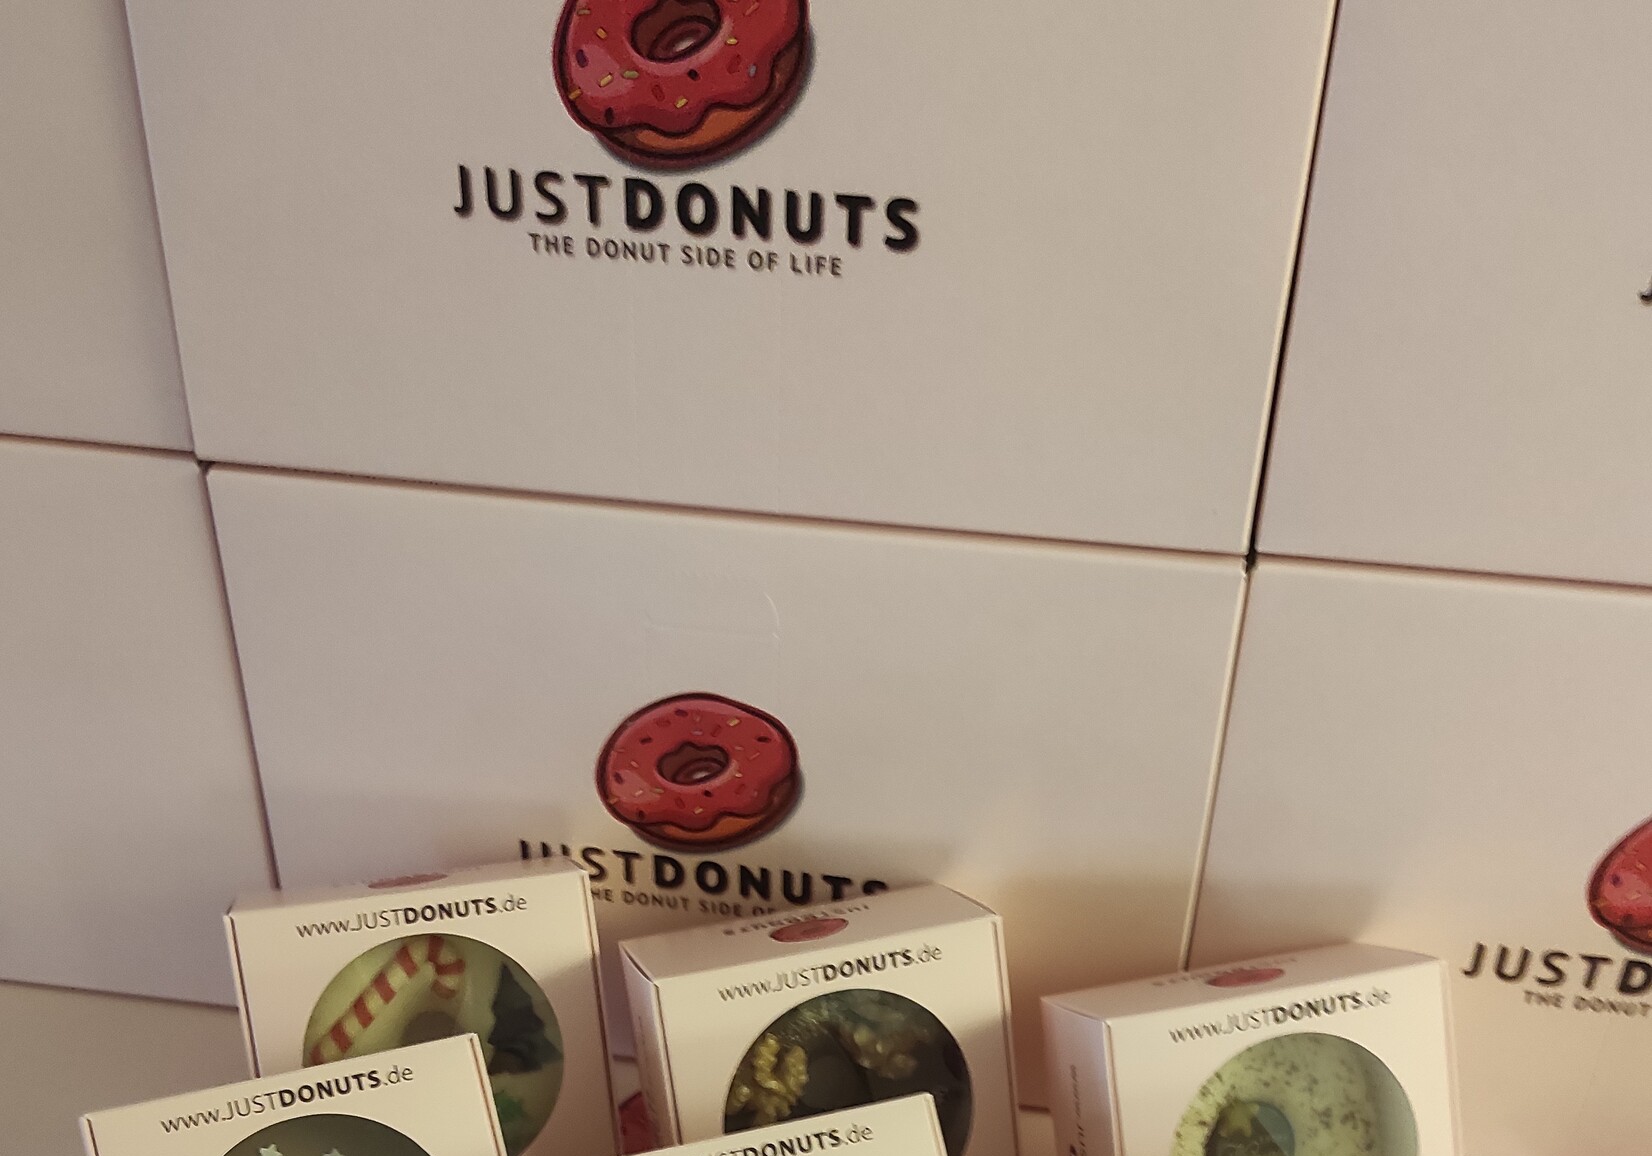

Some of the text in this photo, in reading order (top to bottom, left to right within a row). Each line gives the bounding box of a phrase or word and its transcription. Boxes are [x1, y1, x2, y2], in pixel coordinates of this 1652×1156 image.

[453, 163, 921, 254] JUSTDONUTS
[528, 232, 843, 277] THE DONUT SIDE OF LIFE
[295, 895, 528, 938] www.JUSTDONUTS.de
[591, 887, 615, 903] HE
[621, 890, 690, 911] DONUT
[700, 901, 741, 917] SIDE
[718, 943, 943, 1001] www.JUSTDONUTS.de
[1169, 987, 1392, 1044] www.JUSTDONUTS.de
[1523, 990, 1565, 1008] THE
[160, 1065, 414, 1134] www.JUSTDONUTS.de
